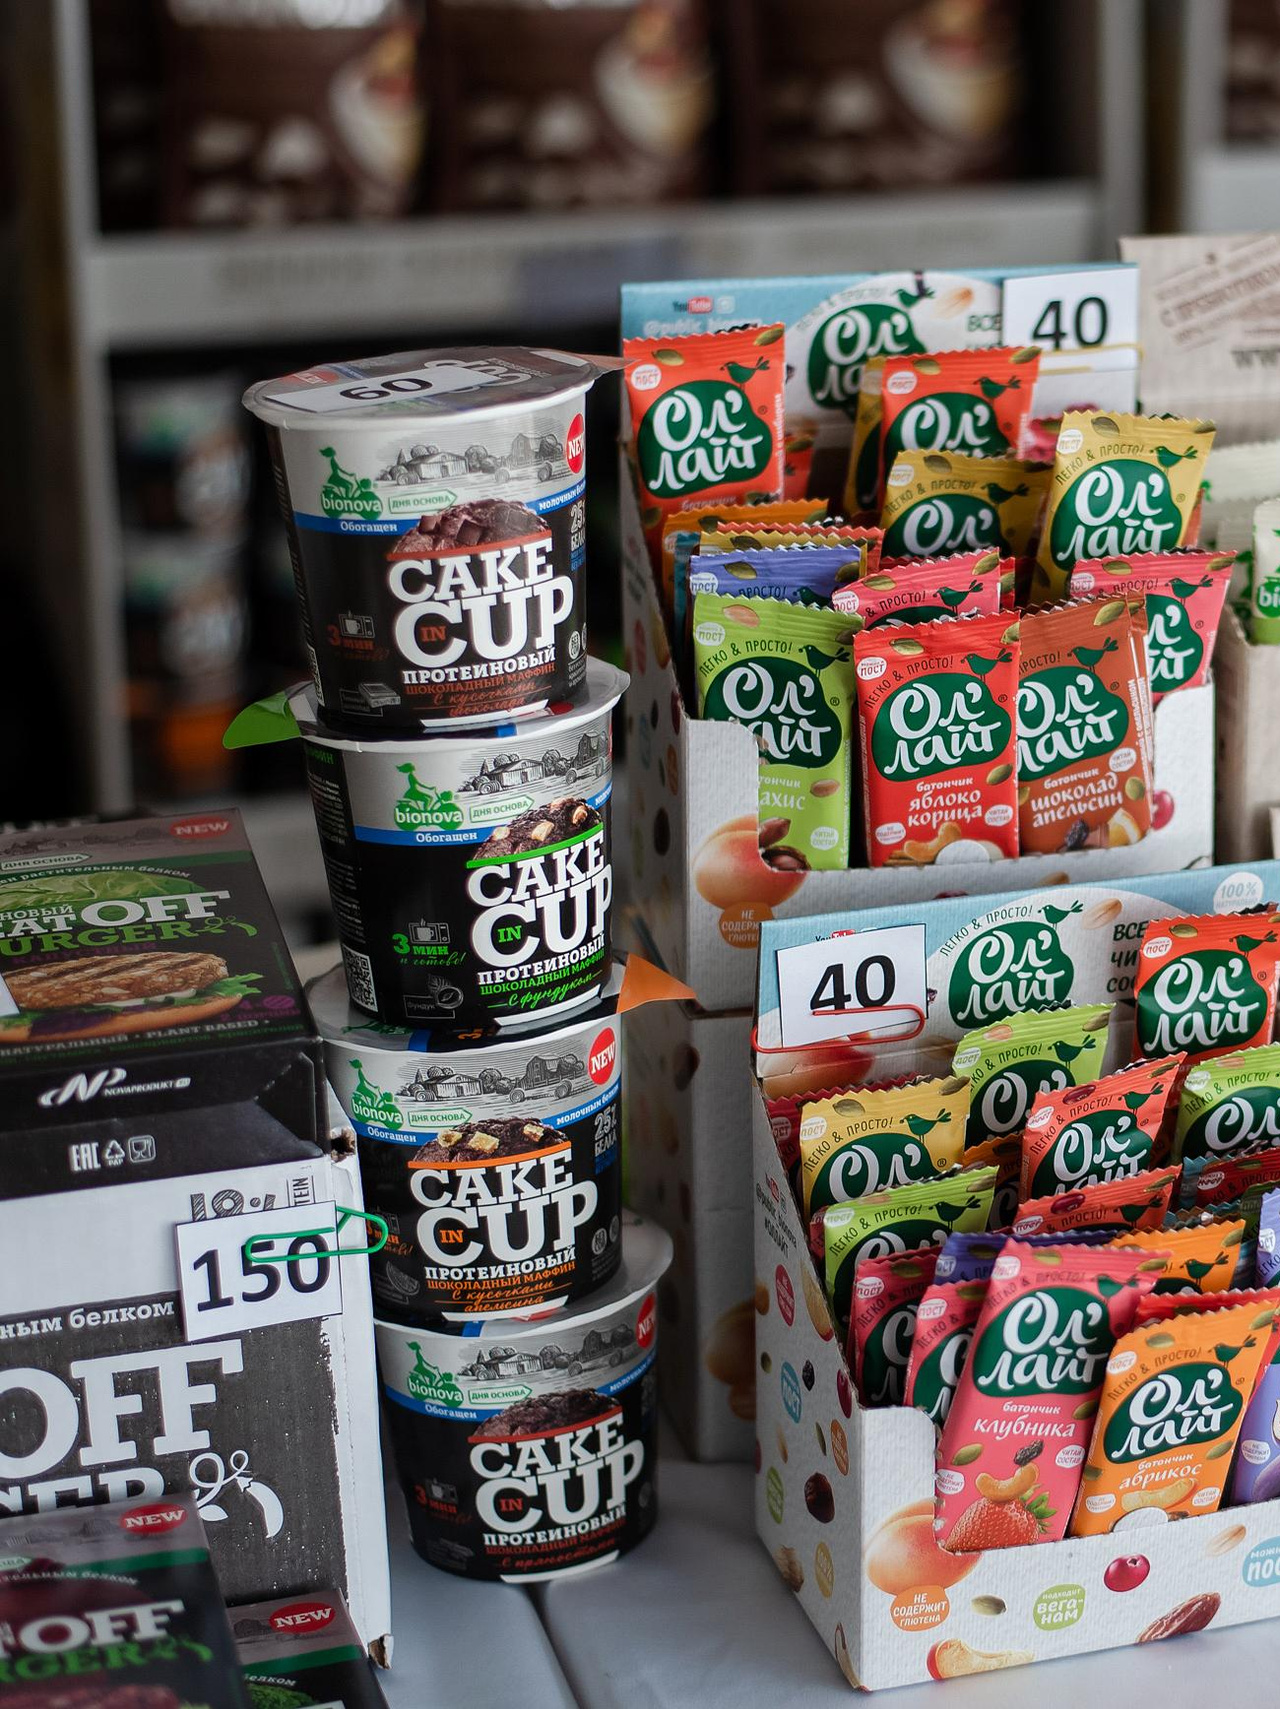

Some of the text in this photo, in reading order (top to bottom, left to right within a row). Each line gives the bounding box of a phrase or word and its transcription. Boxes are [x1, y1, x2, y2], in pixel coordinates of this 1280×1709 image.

[1032, 297, 1109, 349] 40
[1055, 445, 1144, 486] ЛЕГКО ПРОСТО!
[321, 492, 382, 513] bionova
[392, 496, 450, 510] ДНЯ ОСНОВА
[340, 521, 398, 532] Обогащен
[388, 538, 553, 602] CAKE
[879, 590, 926, 612] ПРОСТО!
[395, 576, 574, 668] IN CUP
[402, 646, 556, 684] ПРОТЕИНОВЫЙ
[700, 639, 793, 677] ЛЕГКО ПРОСТО!
[406, 677, 505, 695] ШОКОЛАДНЫЙ
[508, 663, 555, 685] МАФФИН
[864, 656, 954, 709] ЛЕГКО ПРОСТО!
[916, 776, 974, 793] батончик
[1030, 771, 1119, 812] шоколад
[1043, 767, 1100, 790] батончик
[473, 801, 529, 818] ДНЯ ОСНОВА
[908, 789, 981, 812] яблоко
[1032, 792, 1123, 829] апельсин
[175, 821, 229, 835] NEW
[395, 808, 463, 824] bionova
[907, 805, 983, 831] корица
[416, 832, 478, 843] Обогащен
[467, 830, 604, 907] CAKE
[81, 890, 231, 927] OFF
[472, 864, 613, 967] IN CUP
[392, 934, 448, 956] 3 мин
[941, 905, 1033, 957] ЛЕГКО ПРОСТО!
[478, 934, 604, 985] ПРОТЕИНОВЫЙ
[480, 948, 604, 995] ШОКОЛАДНЫЙ МАФФИН
[810, 954, 896, 1014] 40
[146, 1019, 258, 1040] PLANT BASED
[590, 1043, 615, 1073] NEW
[999, 1045, 1042, 1063] ПРОСТО!
[104, 1080, 174, 1097] NOVAPRODUKT
[1227, 1072, 1269, 1086] ПРОСТО!
[352, 1100, 402, 1123] bionova
[367, 1099, 602, 1143] Обогащен молочным
[411, 1112, 467, 1123] ДНЯ ОСНОВА
[1030, 1096, 1113, 1154] ЛЕГКО ПРОСТО!
[803, 1117, 893, 1173] ЛЕГКО ПРОСТО!
[108, 1158, 124, 1166] PAP
[410, 1148, 574, 1209] CAKE
[416, 1180, 598, 1267] IN CUP
[830, 1204, 923, 1257] ЛЕГКО ПРОСТО!
[193, 1235, 331, 1313] 150
[424, 1246, 576, 1279] ПРОТЕИНОВЫЙ
[427, 1262, 576, 1290] ШОКОЛАДНЫЙ МАФФИН
[69, 1300, 175, 1330] белком
[408, 1376, 463, 1403] bionova
[471, 1388, 526, 1400] ДНЯ ОСНОВА
[0, 1338, 244, 1480] OFF
[425, 1404, 477, 1419] Обогащен
[1002, 1401, 1062, 1415] батончик
[973, 1413, 1076, 1441] клубника
[469, 1415, 624, 1479] CAKE
[1137, 1452, 1194, 1471] батончик
[475, 1439, 645, 1533] IN CUP
[1118, 1462, 1203, 1492] абрикос
[124, 1509, 185, 1528] NEW
[483, 1502, 626, 1546] ПРОТЕИНОВЫЙ
[893, 1601, 948, 1617] СОДЕРЖИТ
[913, 1593, 928, 1604] НЕ
[19, 1601, 186, 1652] OFF
[274, 1608, 332, 1628] NEW
[900, 1616, 941, 1627] ГЛЮТЕНА
